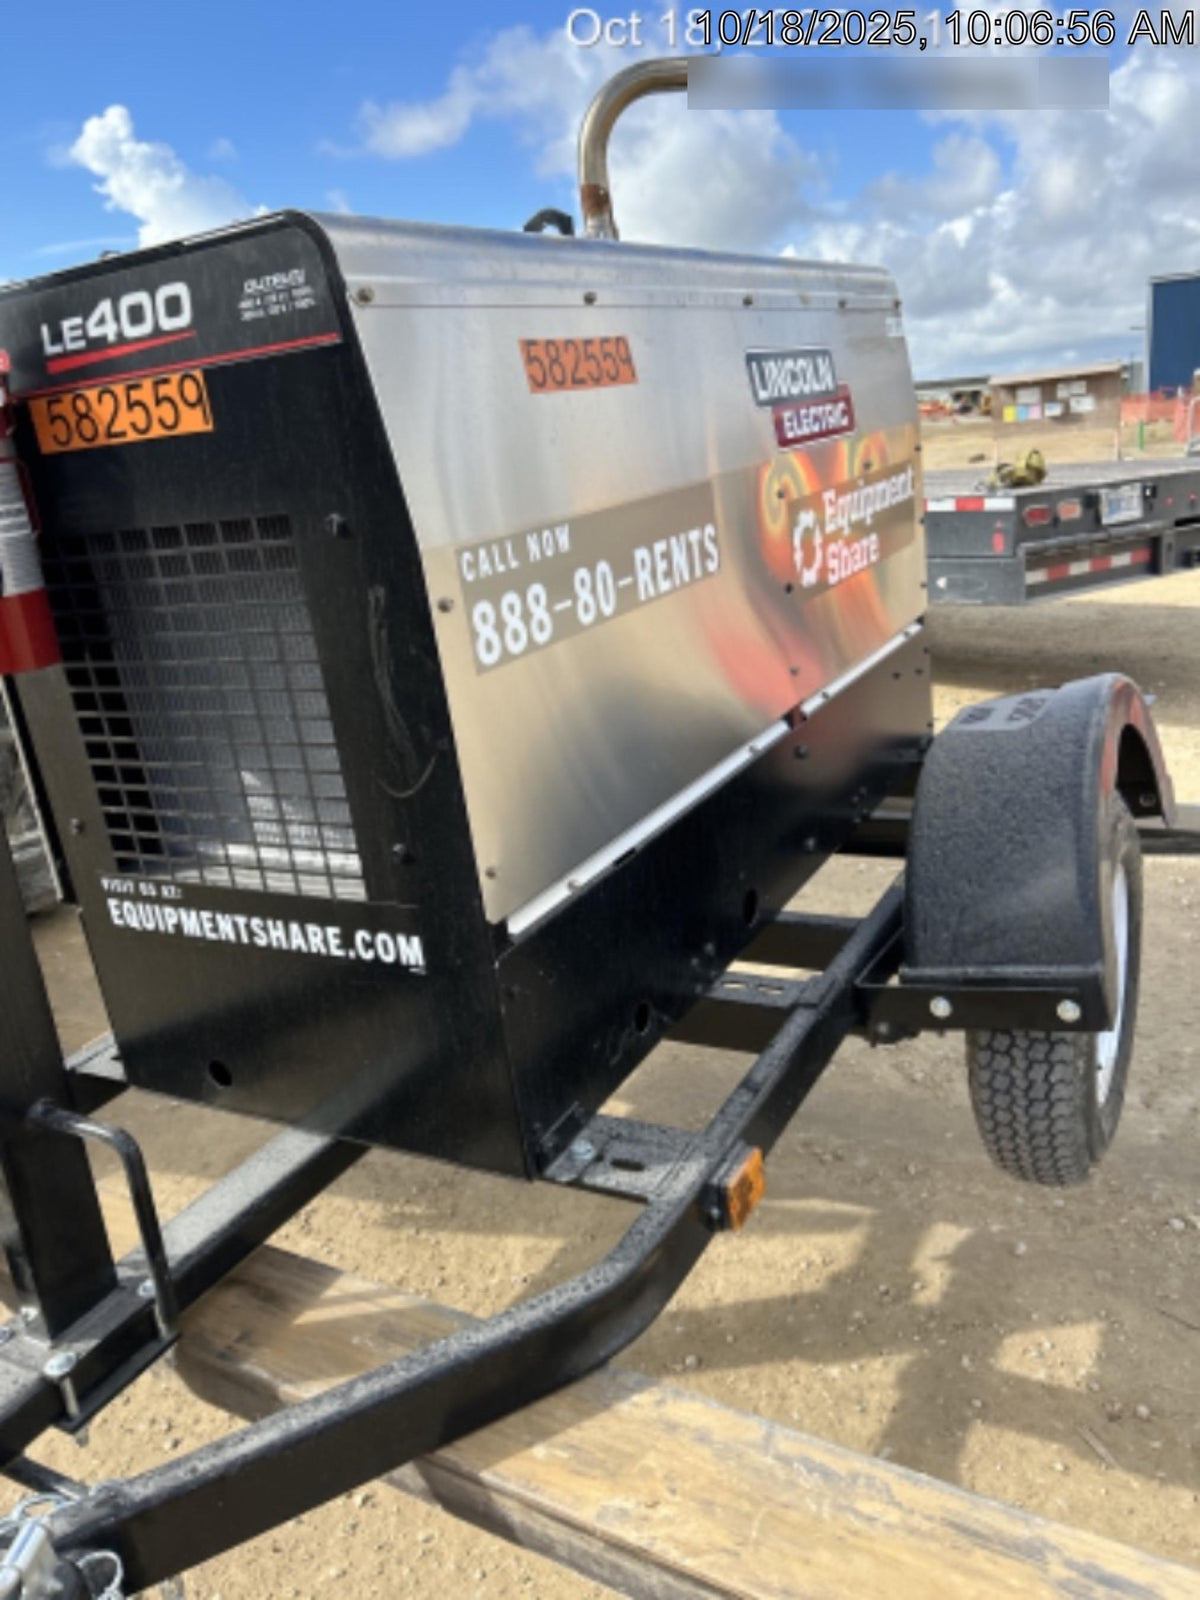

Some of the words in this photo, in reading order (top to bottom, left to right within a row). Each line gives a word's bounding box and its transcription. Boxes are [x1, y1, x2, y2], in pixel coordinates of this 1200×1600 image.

[40, 280, 193, 356] LE400
[524, 335, 637, 389] 582559
[751, 355, 835, 400] LINCOLN
[46, 372, 211, 448] 582559
[783, 402, 849, 439] ELECTRIC
[822, 465, 914, 536] Equipment
[460, 547, 519, 582] CALL
[526, 524, 571, 562] NOW
[827, 533, 879, 586] Share
[472, 523, 721, 666] 888-80-RENTS
[106, 898, 426, 968] EQUIPMENTSHARE.COM
